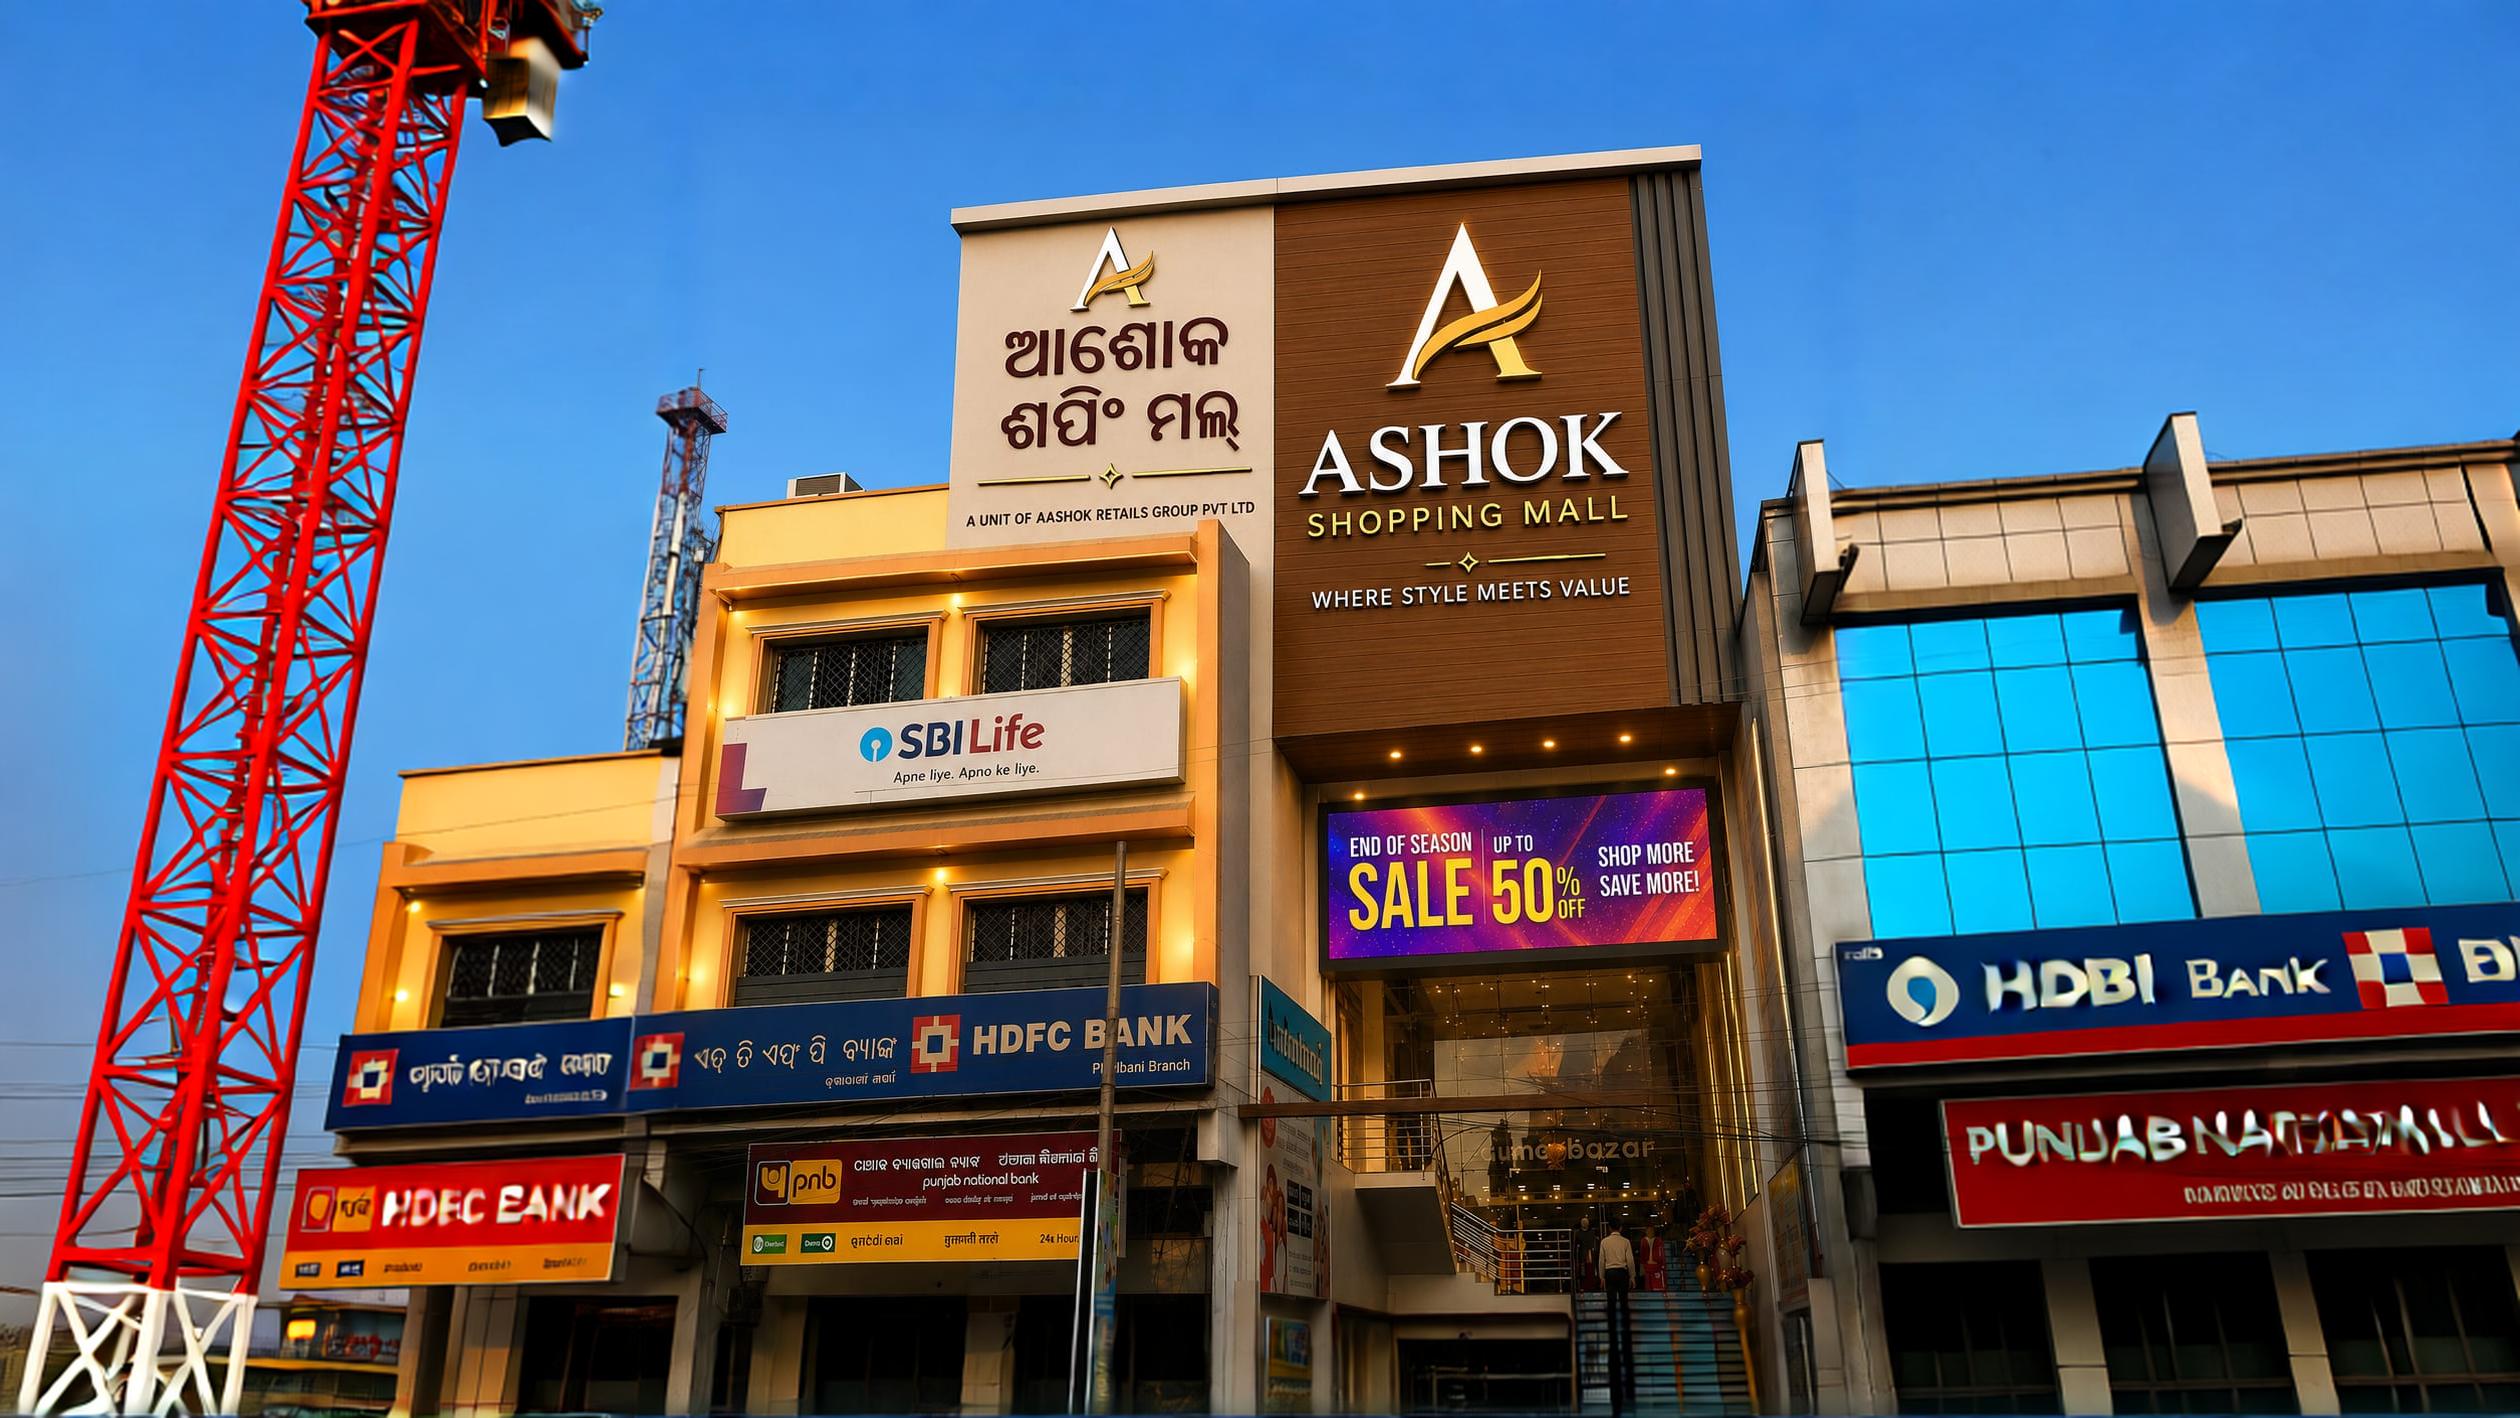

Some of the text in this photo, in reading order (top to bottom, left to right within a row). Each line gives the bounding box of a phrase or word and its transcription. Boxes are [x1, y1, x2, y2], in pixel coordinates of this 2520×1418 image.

[1004, 317, 1229, 378] ଆଶୋକ
[1000, 385, 1125, 449] ଶପିଂ
[1298, 411, 1629, 496] ASHOK
[966, 501, 1255, 527] A UNIT OF AASHOK RETAILS GROUP PVT LTD
[1307, 495, 1628, 538] SHOPPING MALL
[1312, 577, 1630, 609] WHERE STYLE MEETS VALUE
[898, 713, 1045, 760] SBI Life
[893, 762, 1039, 785] Apne liye. Apno ke liye.
[1350, 831, 1472, 858] END OF SEASON
[1493, 834, 1533, 853] UP TO
[1598, 841, 1695, 867] SHOP MORE
[1348, 857, 1474, 931] SALE
[1600, 870, 1700, 897] SAVE MORE!
[1558, 898, 1586, 919] OFF
[972, 1014, 1193, 1056] HDFC BANK
[1092, 1058, 1190, 1075] Plbani Branch
[792, 1164, 837, 1199] pnb
[922, 1171, 1039, 1191] punjab national bank
